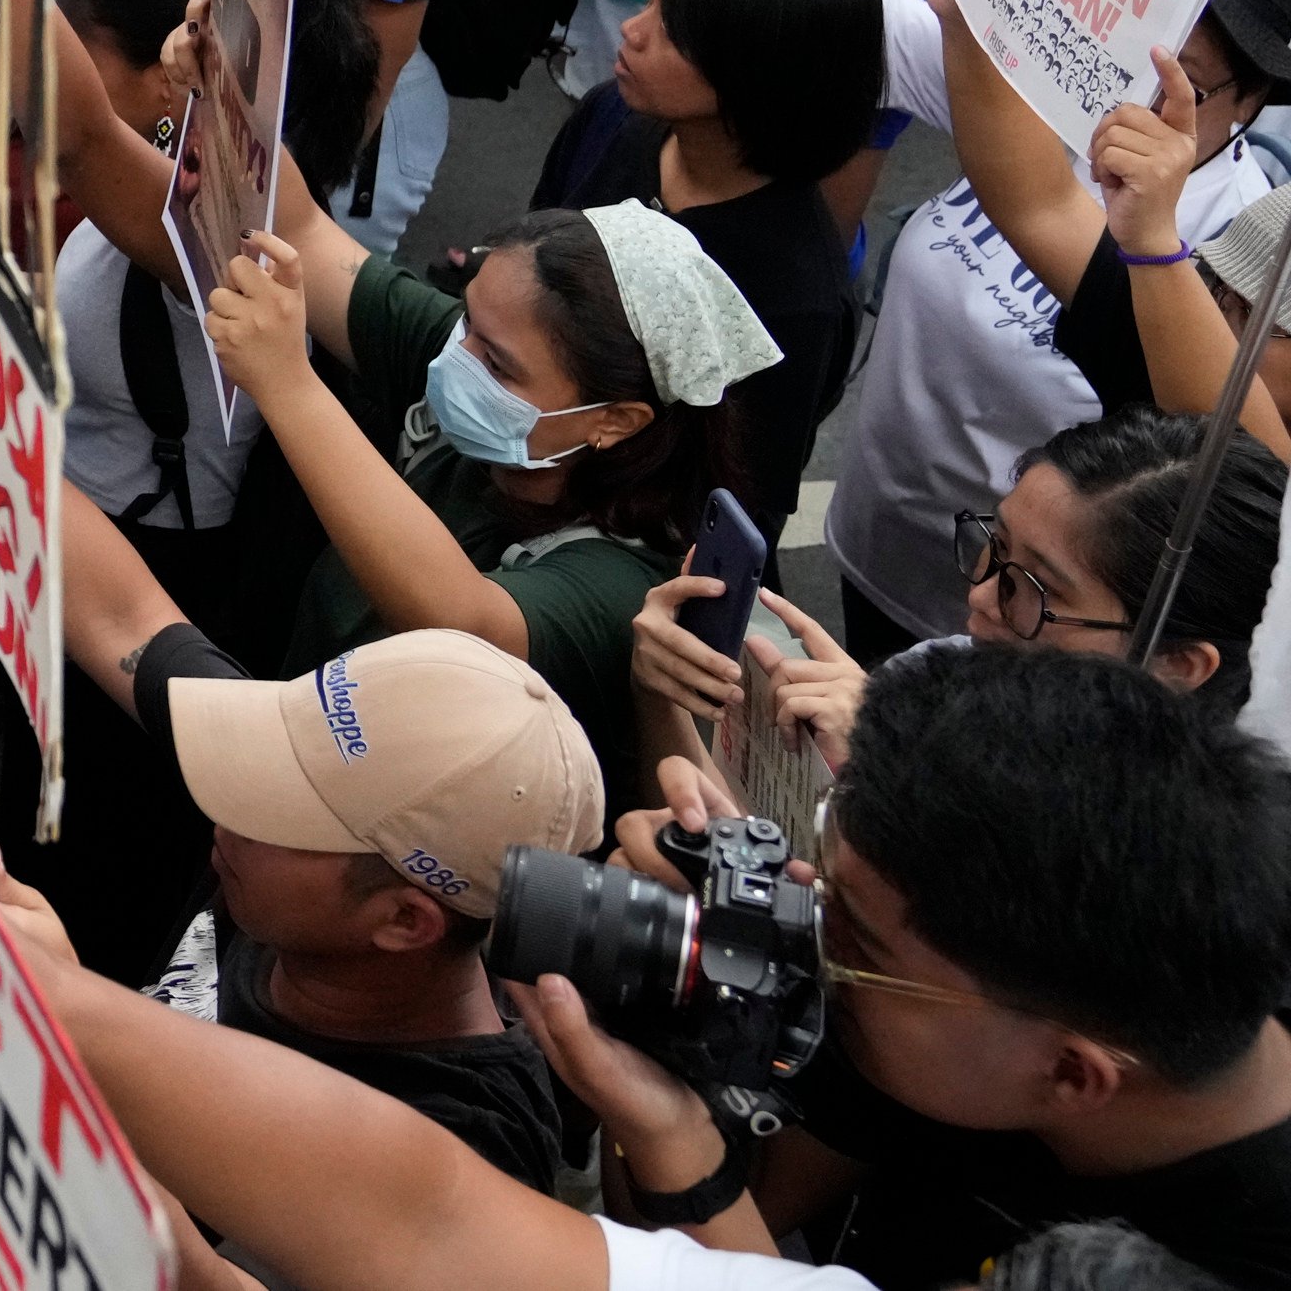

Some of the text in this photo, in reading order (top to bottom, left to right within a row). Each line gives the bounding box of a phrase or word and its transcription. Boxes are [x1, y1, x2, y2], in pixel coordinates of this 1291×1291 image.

[988, 31, 1007, 61] RISE
[1005, 50, 1019, 71] UP
[929, 231, 985, 278] your
[401, 847, 470, 898] 1986
